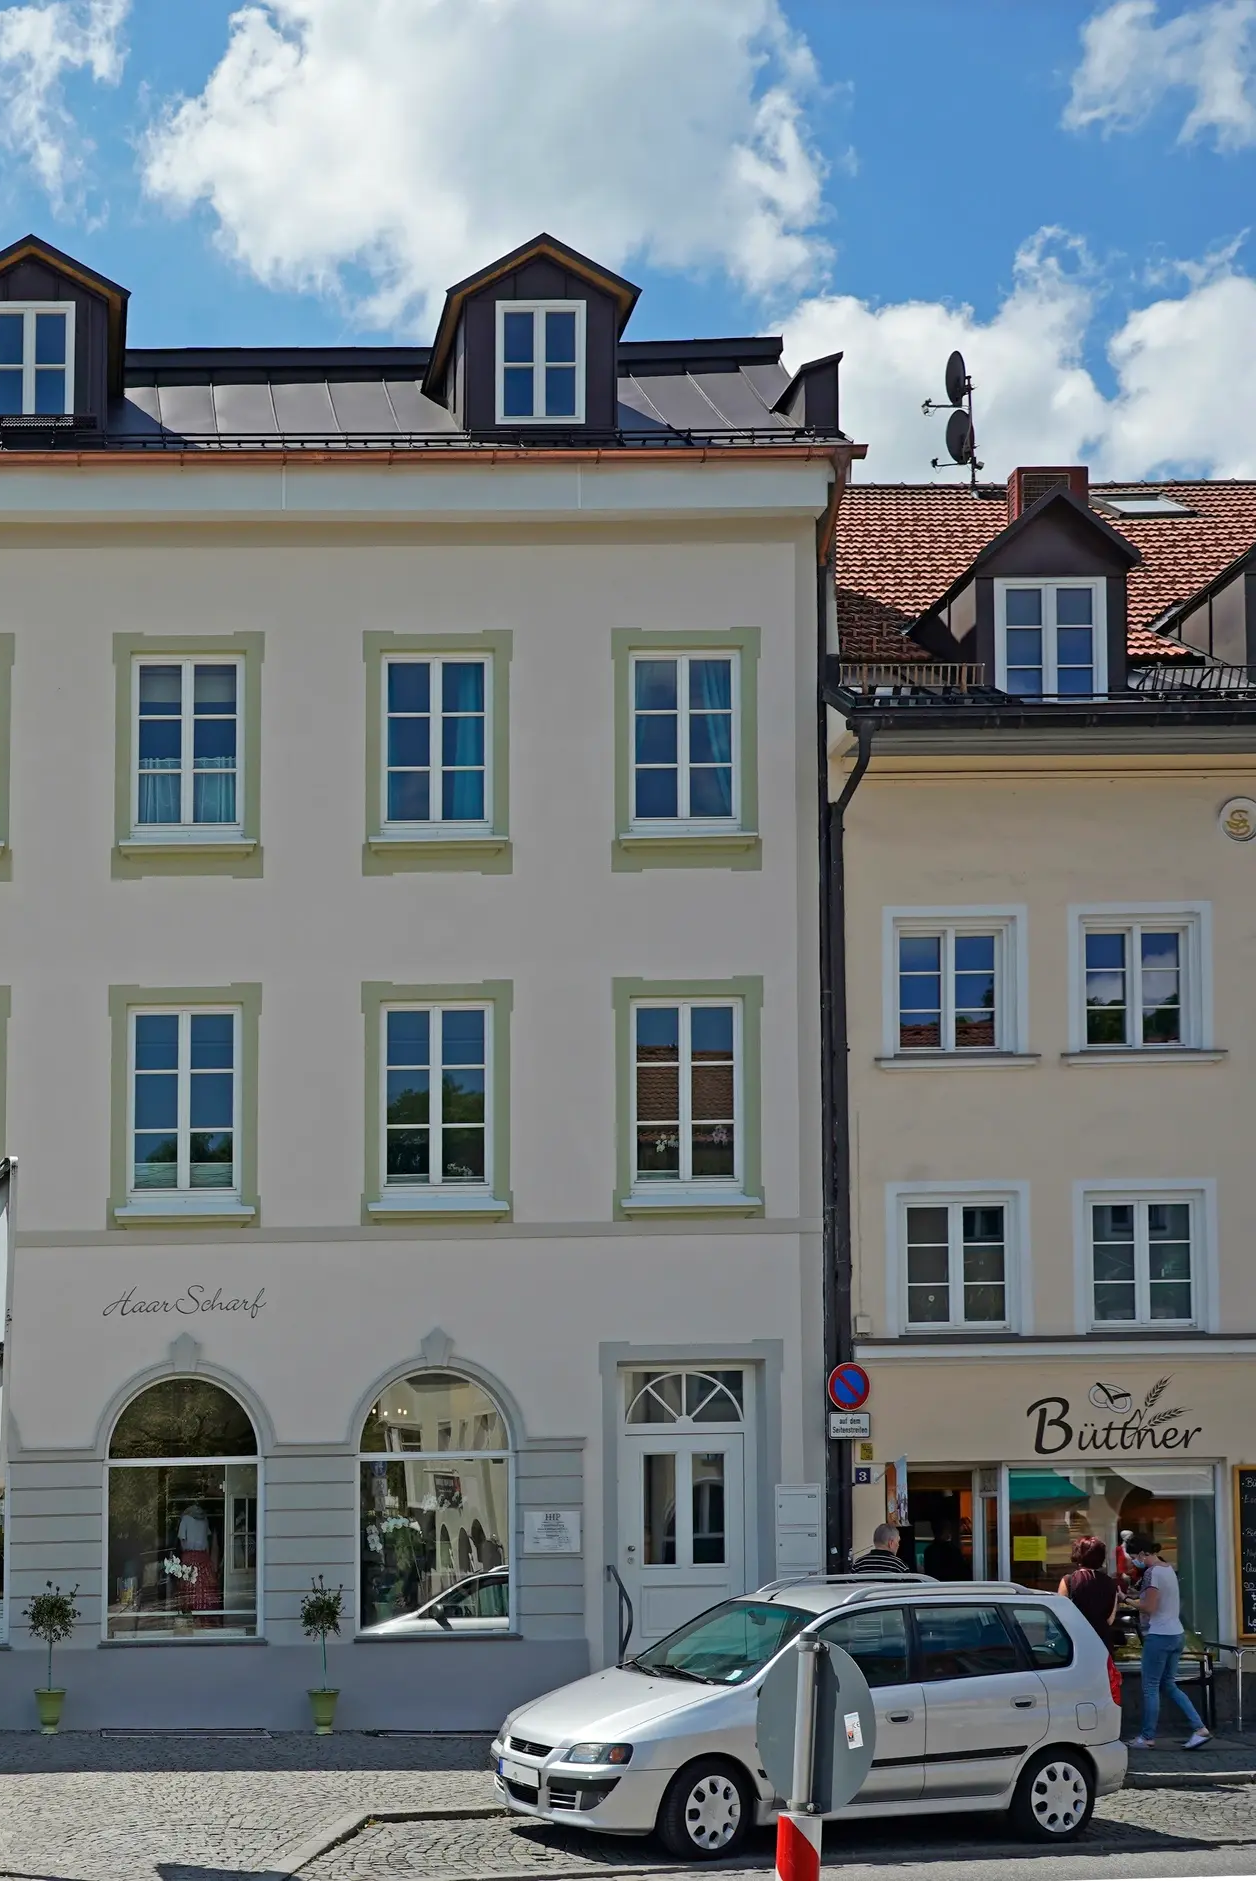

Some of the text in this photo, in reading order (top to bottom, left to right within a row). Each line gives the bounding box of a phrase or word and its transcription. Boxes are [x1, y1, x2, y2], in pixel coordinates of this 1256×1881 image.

[102, 1284, 267, 1319] HaarScharf
[839, 1417, 861, 1425] auf dem
[1026, 1396, 1203, 1455] Büttner
[832, 1426, 868, 1434] Seitenstreifen
[858, 1471, 867, 1482] 3
